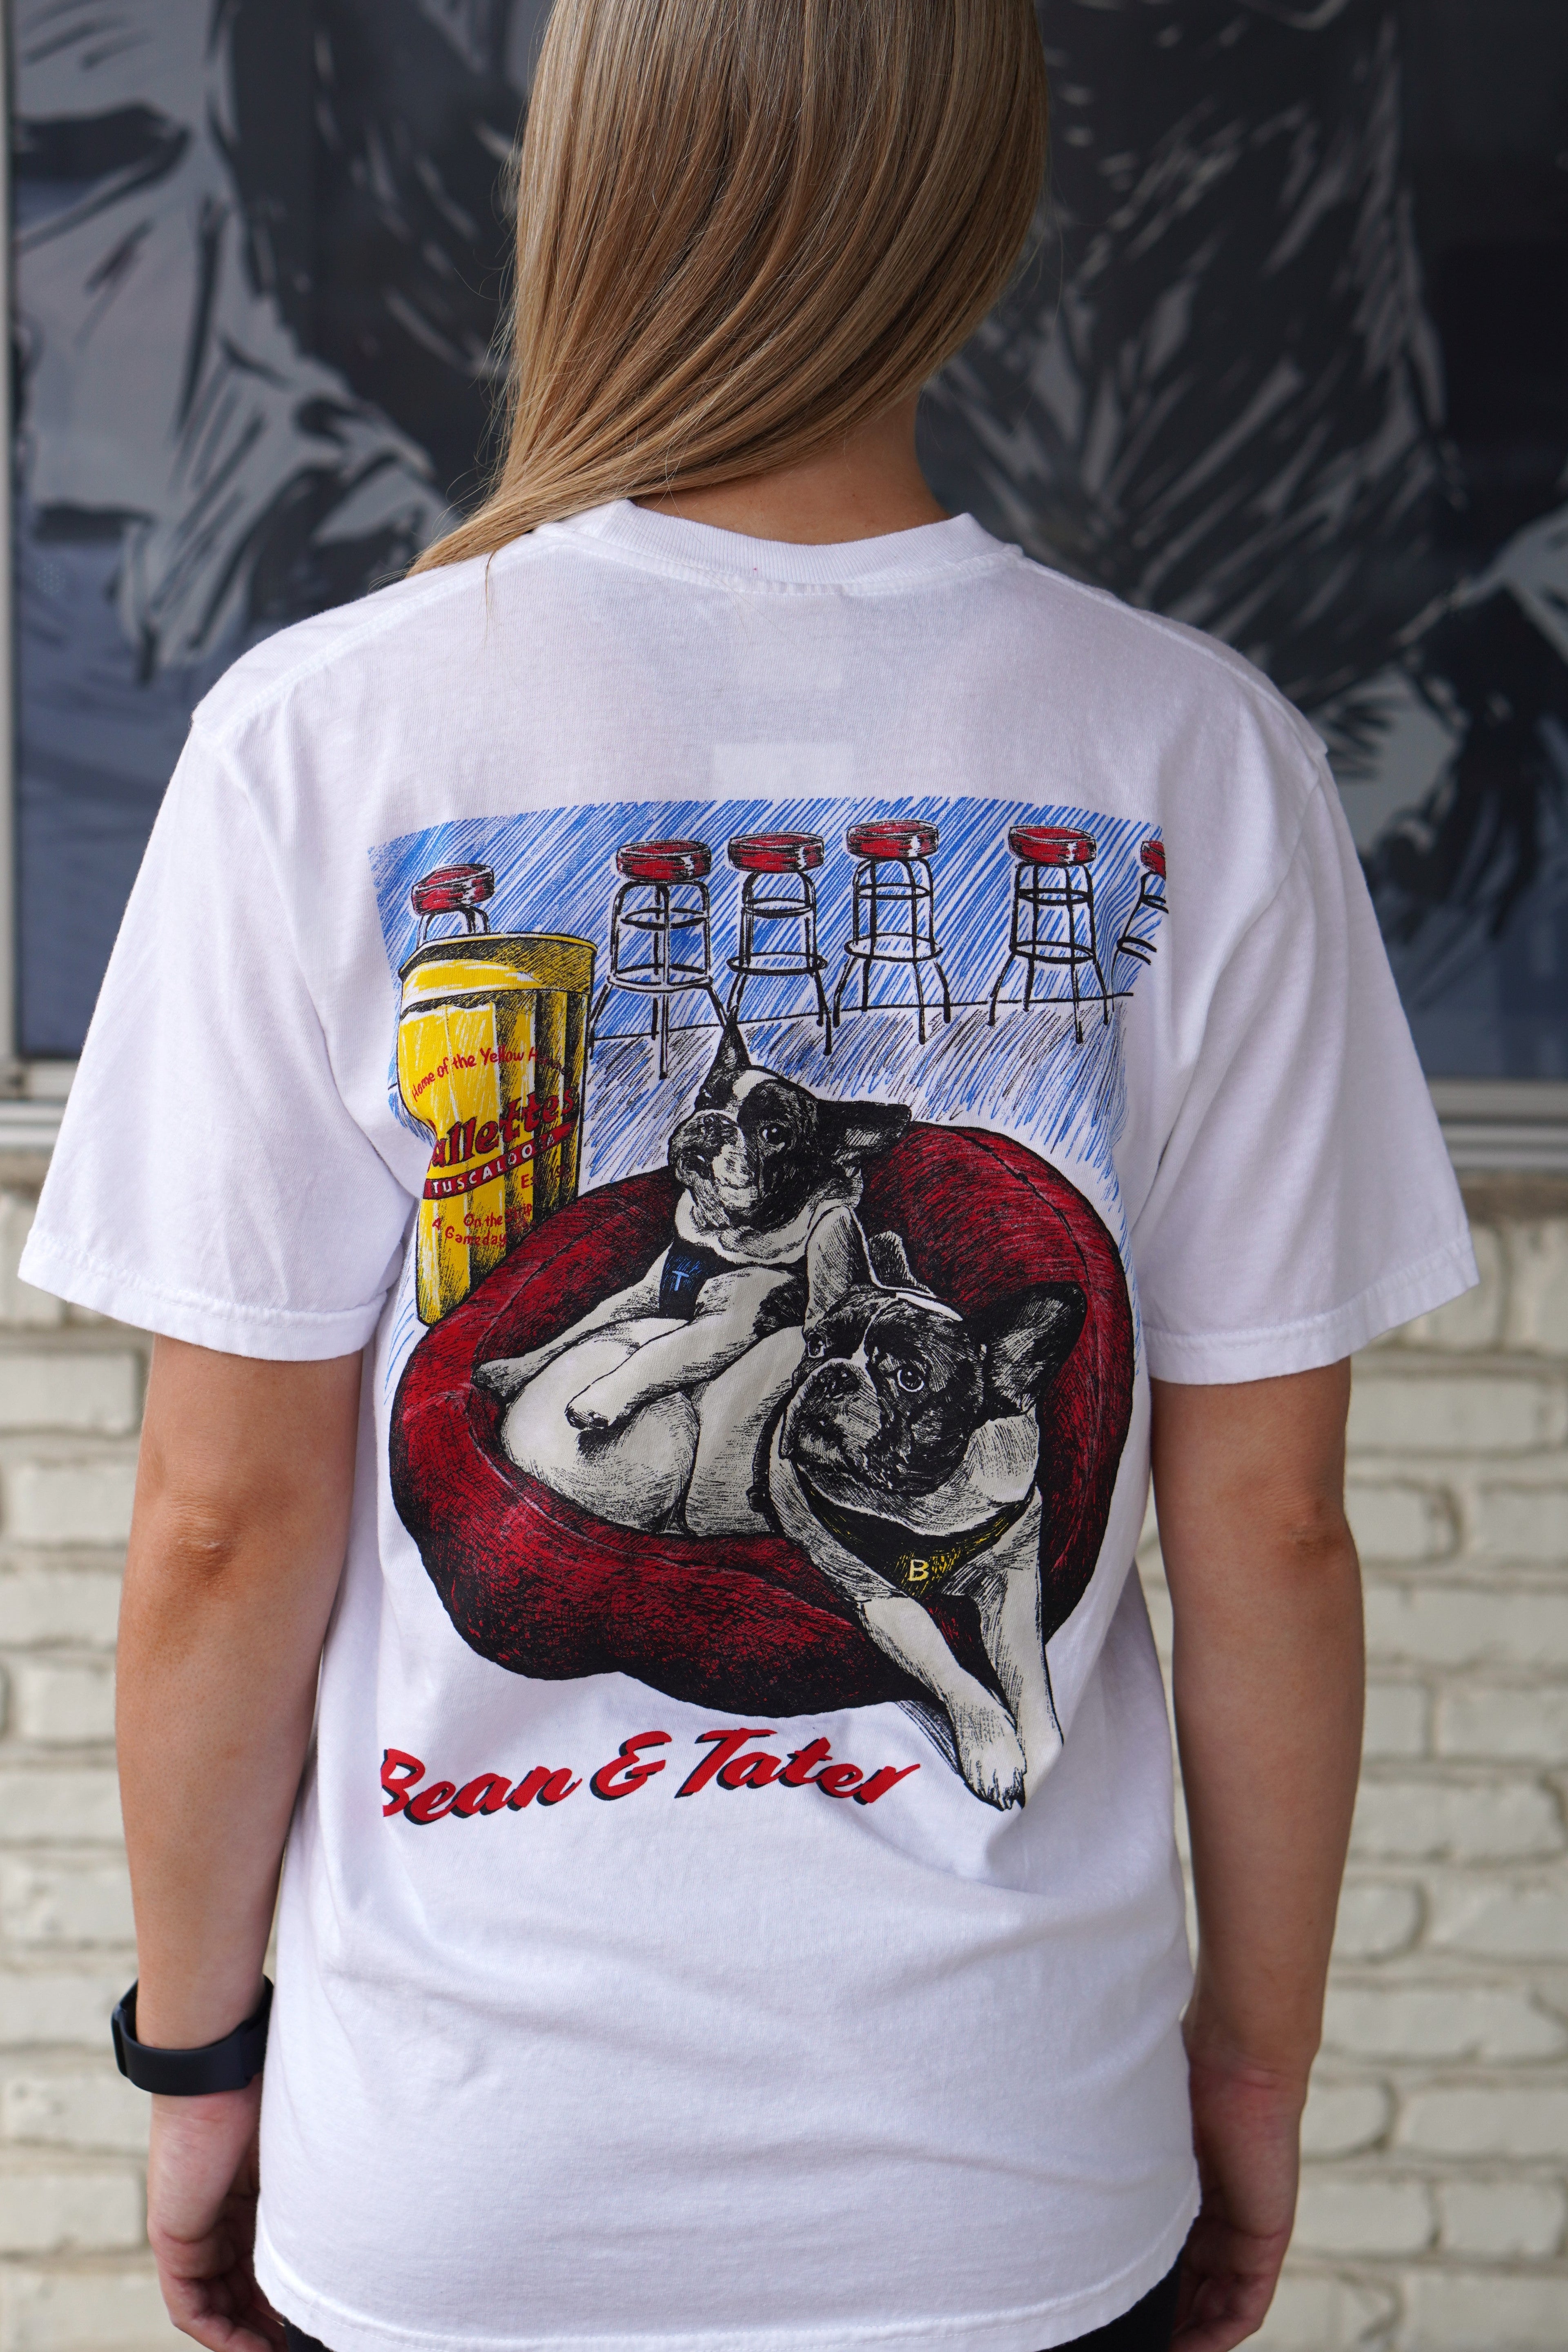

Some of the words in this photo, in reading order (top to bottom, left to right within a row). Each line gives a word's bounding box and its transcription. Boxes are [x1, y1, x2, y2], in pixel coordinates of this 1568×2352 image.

[412, 1071, 436, 1102] Home
[437, 1057, 449, 1078] of
[451, 1053, 477, 1069] the
[479, 1043, 525, 1066] Yellow
[428, 1088, 575, 1169] allettes
[463, 1212, 481, 1228] On
[485, 1212, 503, 1227] the
[445, 1225, 507, 1248] Gameday
[672, 1270, 690, 1292] T
[908, 1559, 929, 1581] B
[380, 1748, 583, 1825] Bean
[590, 1730, 673, 1800] &
[674, 1727, 921, 1804] Tater
